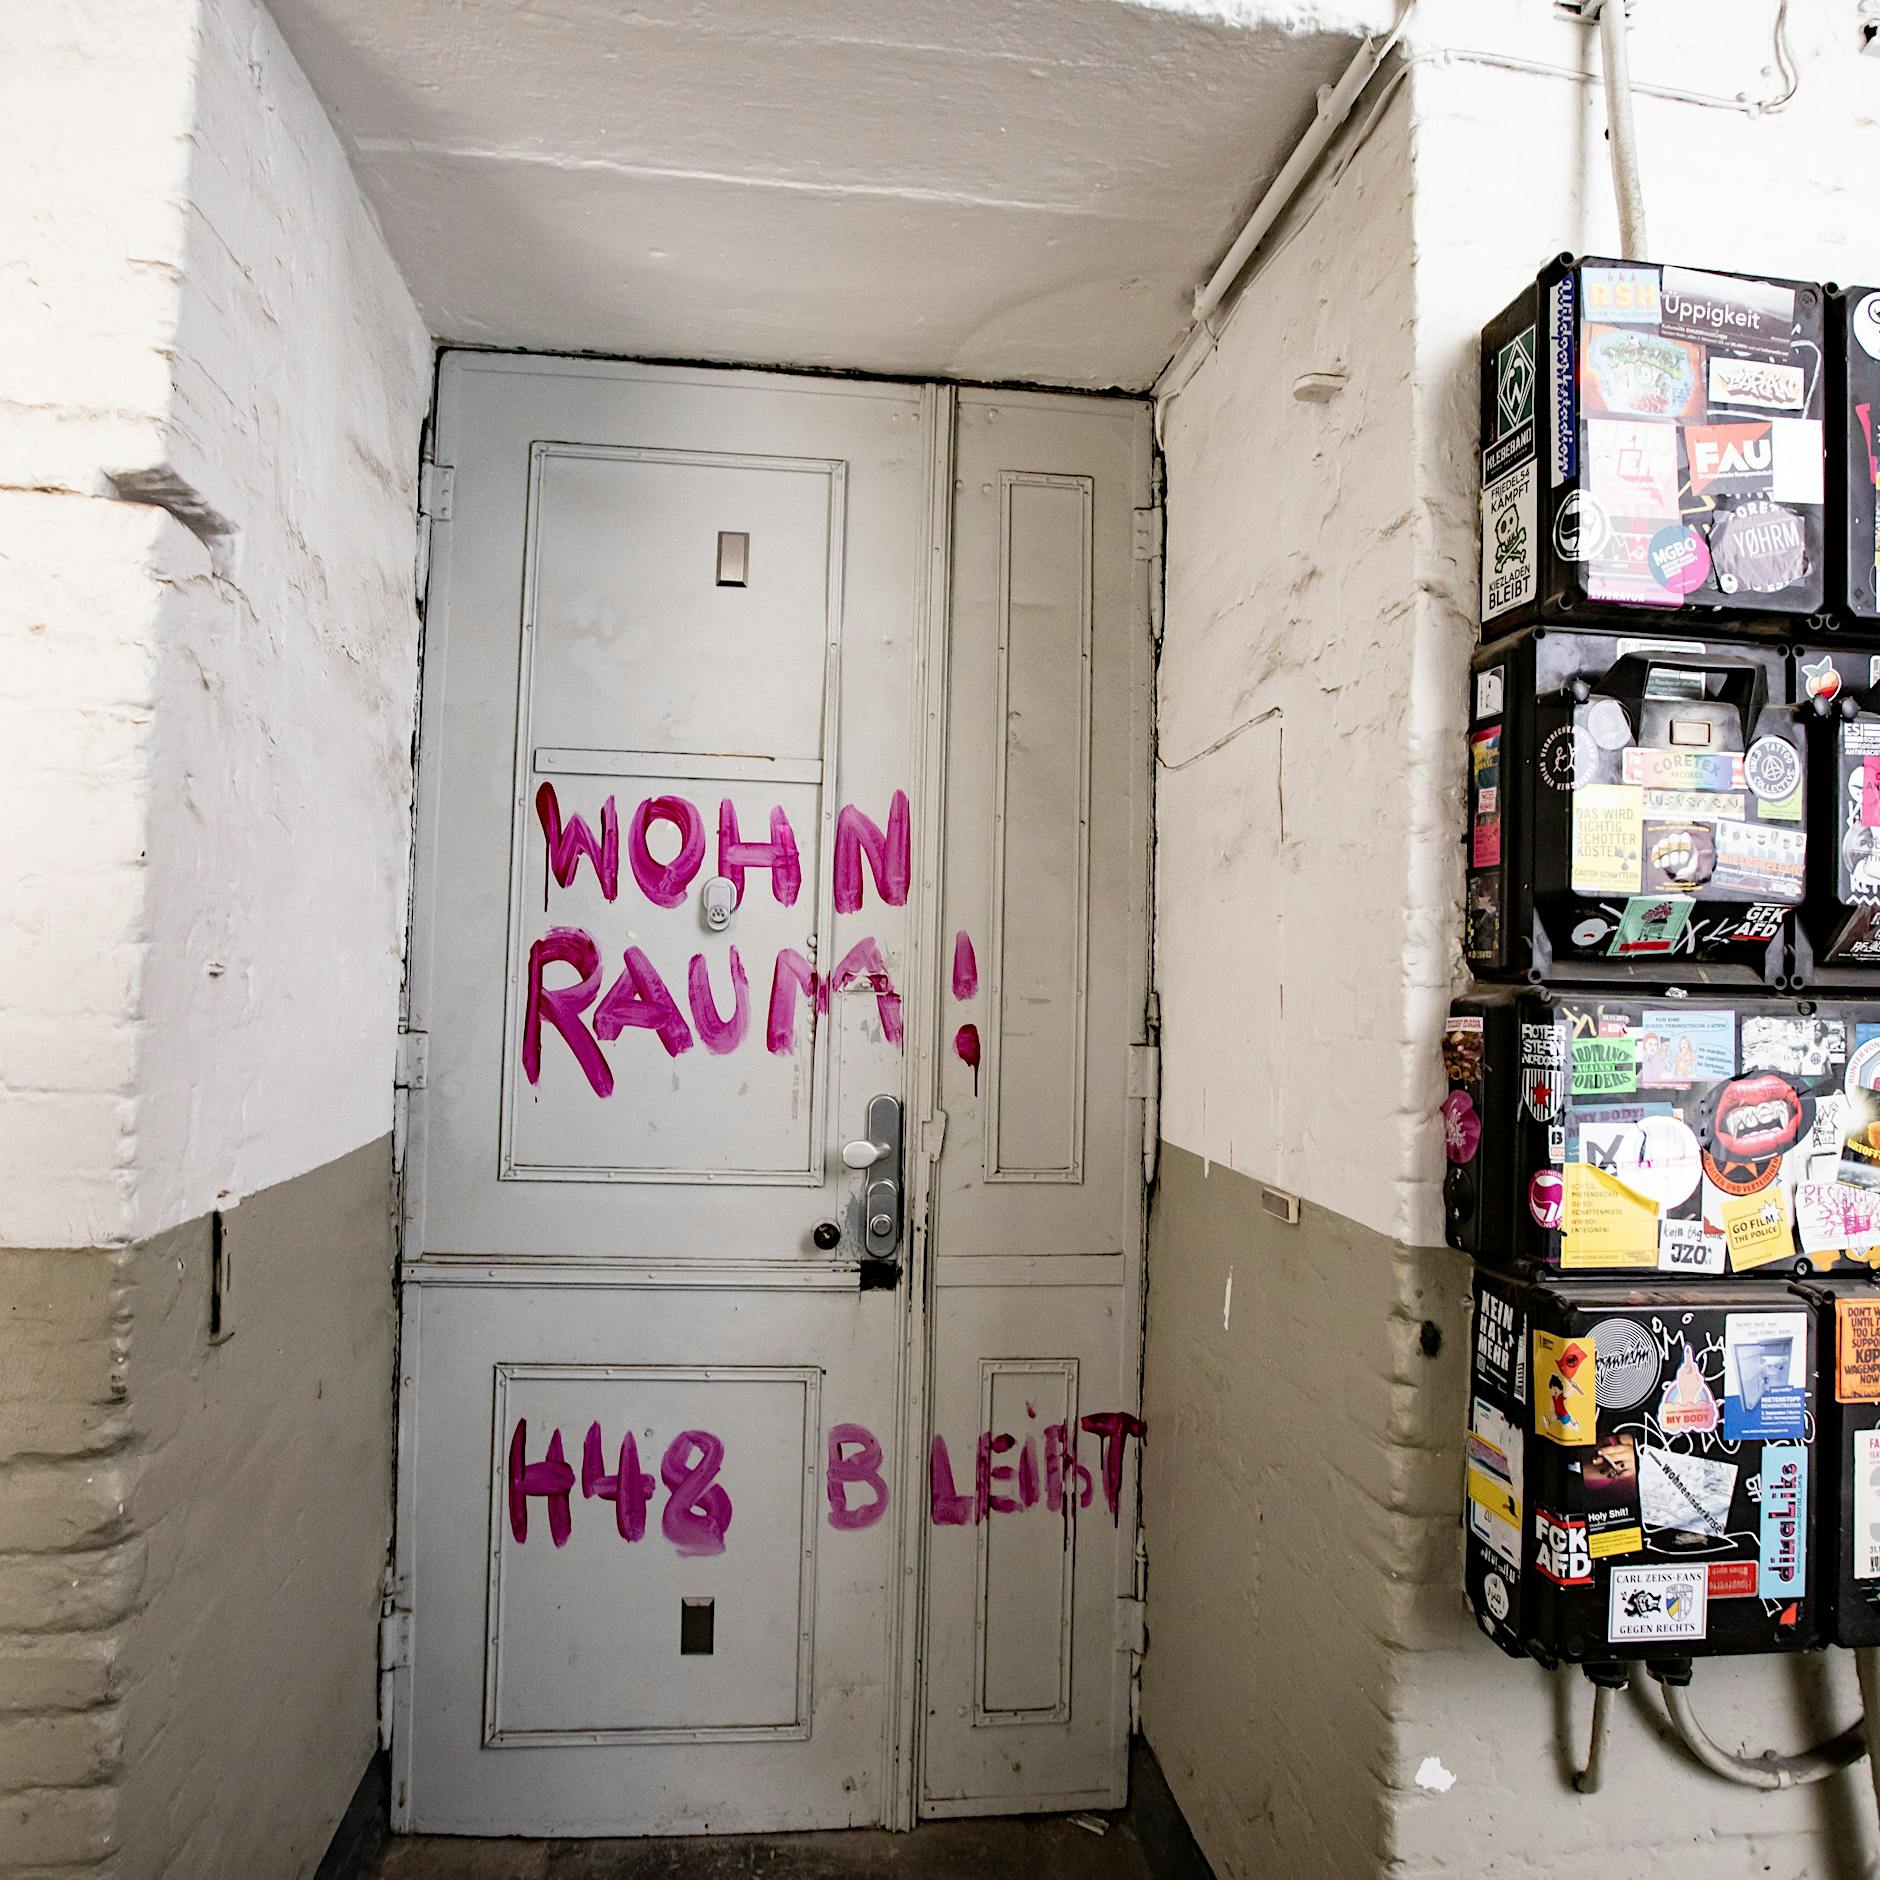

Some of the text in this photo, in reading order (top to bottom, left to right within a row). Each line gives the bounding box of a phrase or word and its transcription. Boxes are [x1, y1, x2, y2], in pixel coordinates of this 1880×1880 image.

[1664, 291, 1761, 329] Üppigkeit
[1486, 427, 1532, 472] KLEBEBAND
[1694, 439, 1772, 473] FAU
[1491, 467, 1530, 499] FRIEDEL54
[1733, 520, 1801, 558] YØHRM
[1489, 563, 1531, 592] KIEZLADEN
[1489, 574, 1531, 611] BLEIBT
[1765, 742, 1794, 764] TATTOO
[1653, 753, 1720, 777] CORETEX
[1576, 808, 1634, 821] DAS WIRD
[1577, 821, 1622, 833] RICHTIG
[536, 781, 911, 913] WOHN
[1577, 833, 1637, 845] SCHOTTER
[1734, 921, 1778, 937] AFD
[1522, 1023, 1567, 1041] ROTER
[1522, 1039, 1566, 1056] STERN
[1572, 1044, 1633, 1063] ARDTRANCE
[1521, 1054, 1567, 1067] NORDOST
[1576, 1063, 1617, 1073] AGAINST
[1726, 1181, 1741, 1193] UND
[1743, 1156, 1780, 1193] VERTEIDIGEN
[1732, 1213, 1776, 1234] GO FILM
[1734, 1234, 1749, 1244] THE
[1750, 1226, 1778, 1240] POLICE
[1481, 1290, 1514, 1332] KEIN
[1851, 1318, 1874, 1327] UNTIL
[1852, 1328, 1868, 1338] TOO
[1478, 1333, 1510, 1371] MEHR
[1666, 1413, 1710, 1425] MY BODY
[1588, 1507, 1629, 1523] Holy Shit!
[1535, 1514, 1588, 1553] FCK
[1535, 1542, 1593, 1579] AFD
[1616, 1574, 1641, 1584] CARL
[1619, 1623, 1695, 1635] GEGEN RECHTS
